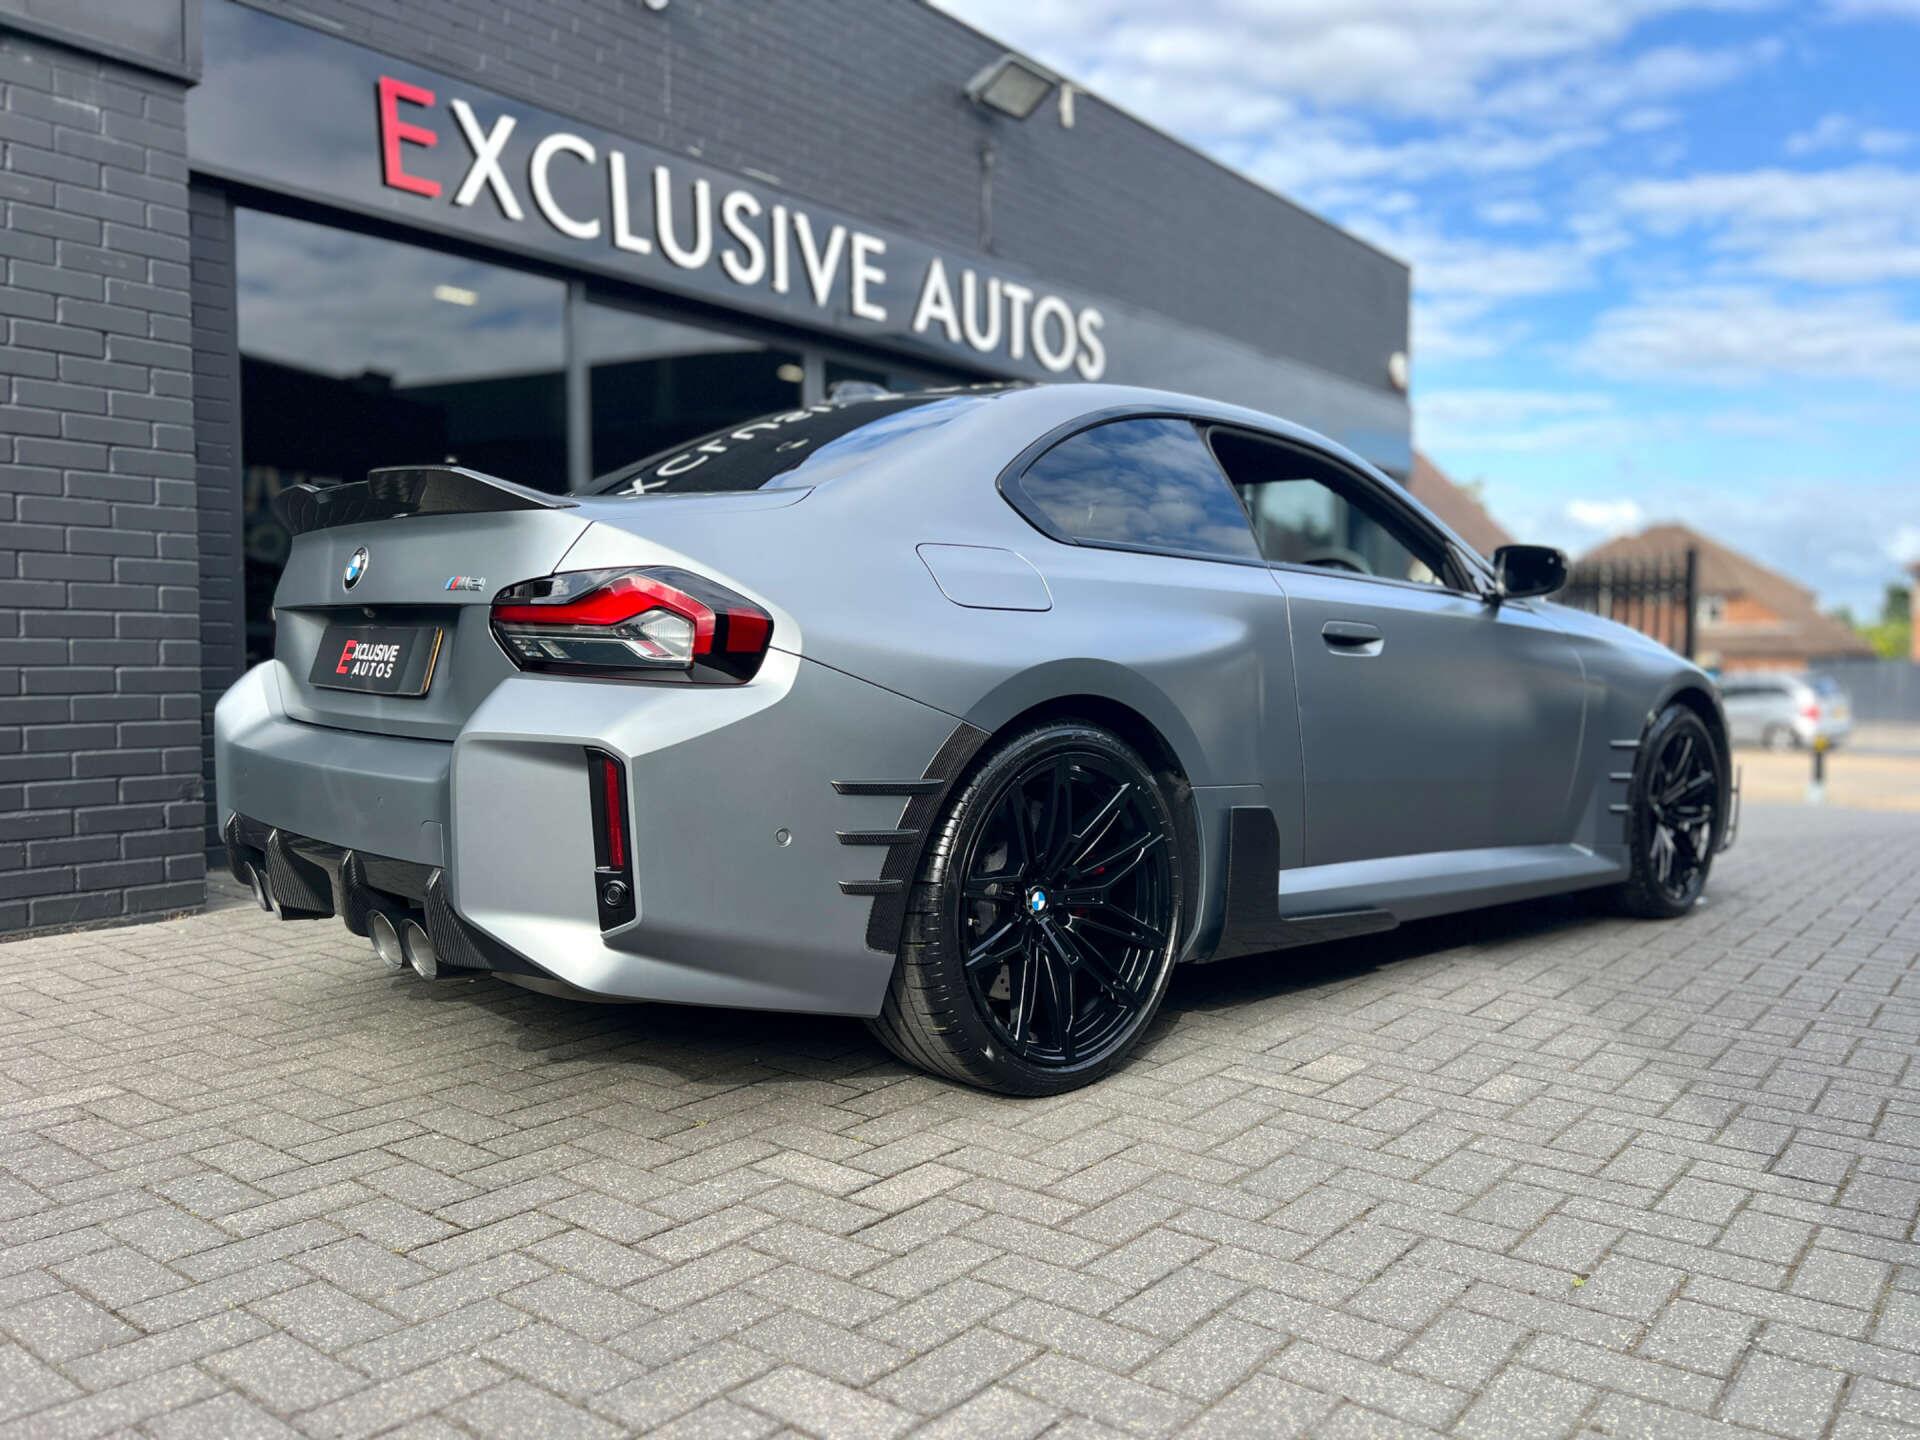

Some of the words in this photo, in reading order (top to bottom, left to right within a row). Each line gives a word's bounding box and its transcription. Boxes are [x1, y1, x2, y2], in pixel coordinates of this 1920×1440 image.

[378, 75, 886, 322] EXCLUSIVE
[913, 258, 1106, 381] AUTOS
[336, 639, 400, 674] EXCLUSIVE
[351, 661, 394, 679] AUTOS
